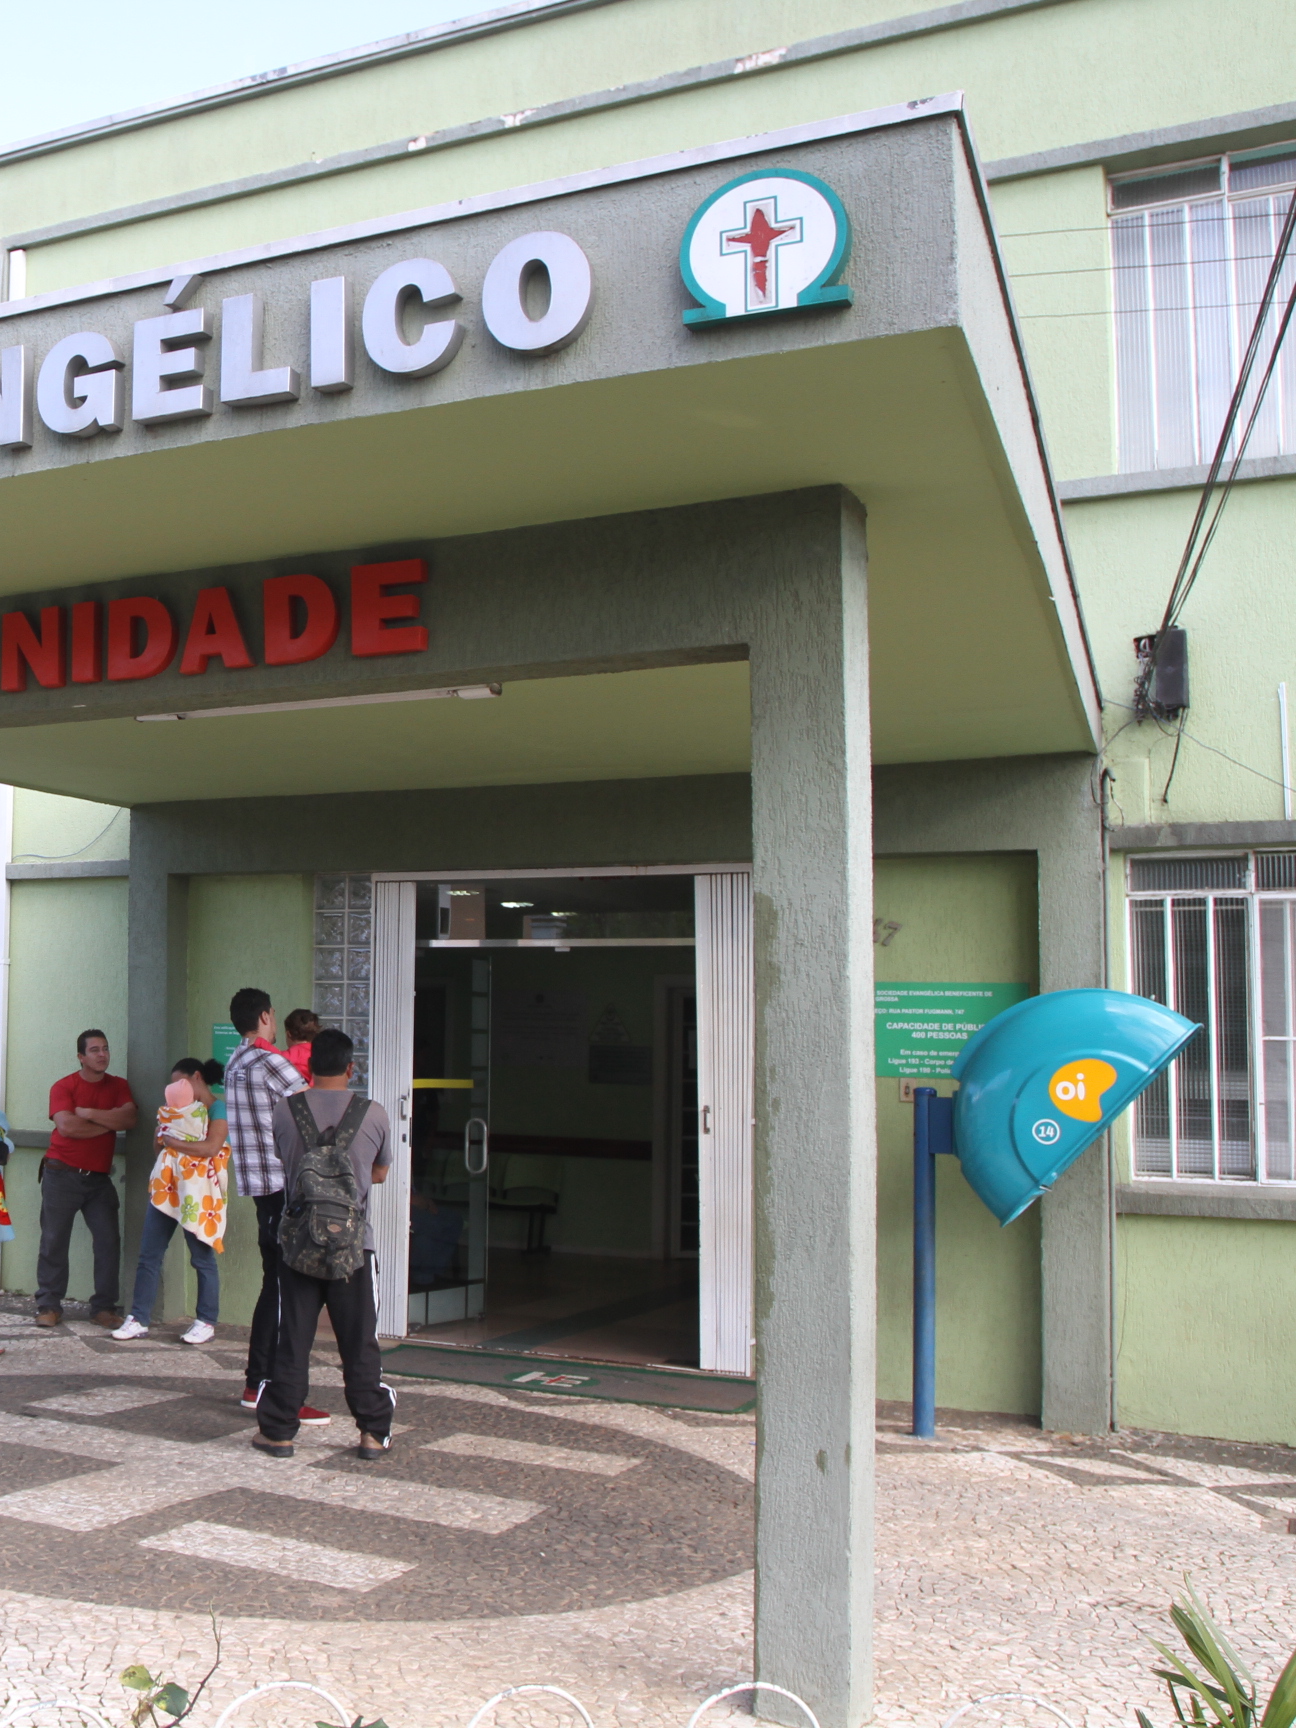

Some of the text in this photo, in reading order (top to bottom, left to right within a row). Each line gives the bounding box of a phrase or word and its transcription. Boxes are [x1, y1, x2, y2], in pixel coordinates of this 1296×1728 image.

[909, 989, 944, 997] EVANGÉLICA
[945, 990, 984, 998] BENEFICENTE
[886, 1021, 987, 1031] CAPACIDADE DE PÚBLI
[911, 1031, 968, 1040] 400 PESSOAS
[888, 1057, 907, 1065] Ligue
[924, 1058, 944, 1066] Corpo
[899, 1066, 918, 1074] Ligue
[1055, 1073, 1086, 1100] oi
[1038, 1125, 1055, 1138] 14
